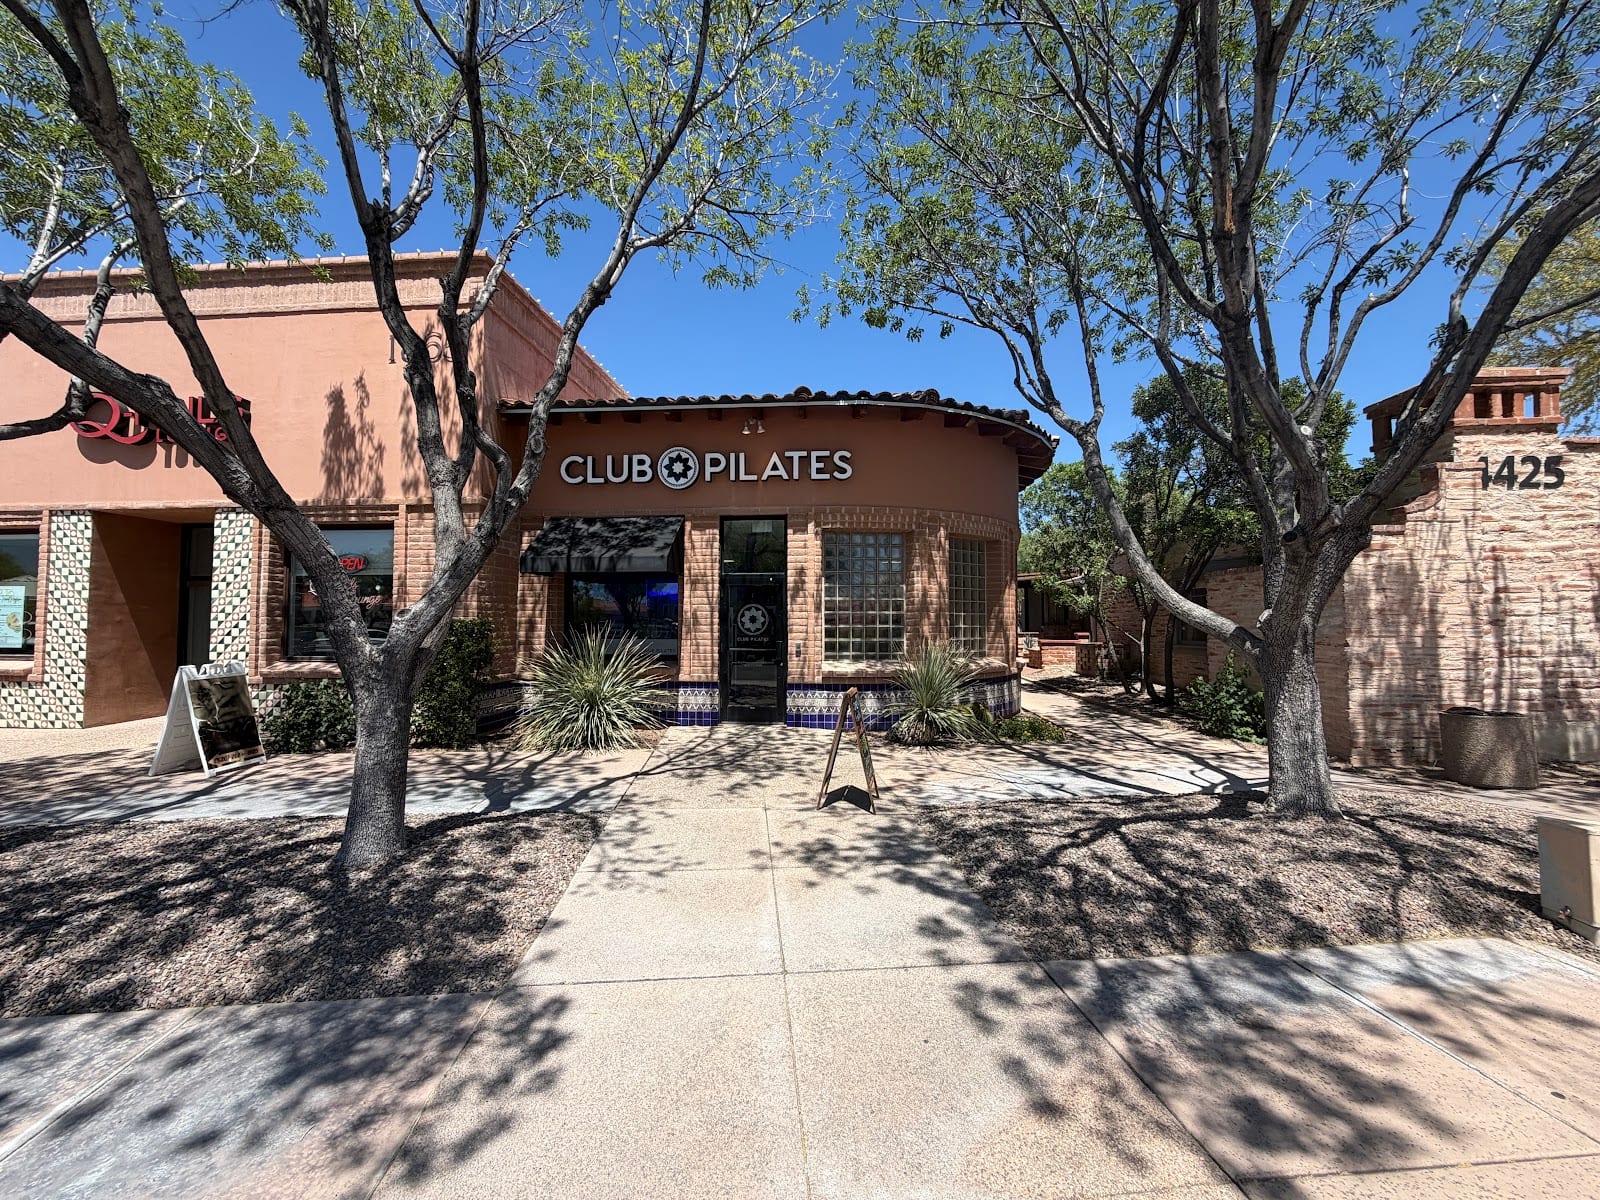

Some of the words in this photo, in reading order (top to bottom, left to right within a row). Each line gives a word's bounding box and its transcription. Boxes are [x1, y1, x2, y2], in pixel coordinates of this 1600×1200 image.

[559, 454, 654, 485] CLUB
[704, 449, 854, 482] PILATES
[1478, 455, 1566, 491] 1425
[340, 557, 366, 571] PEN
